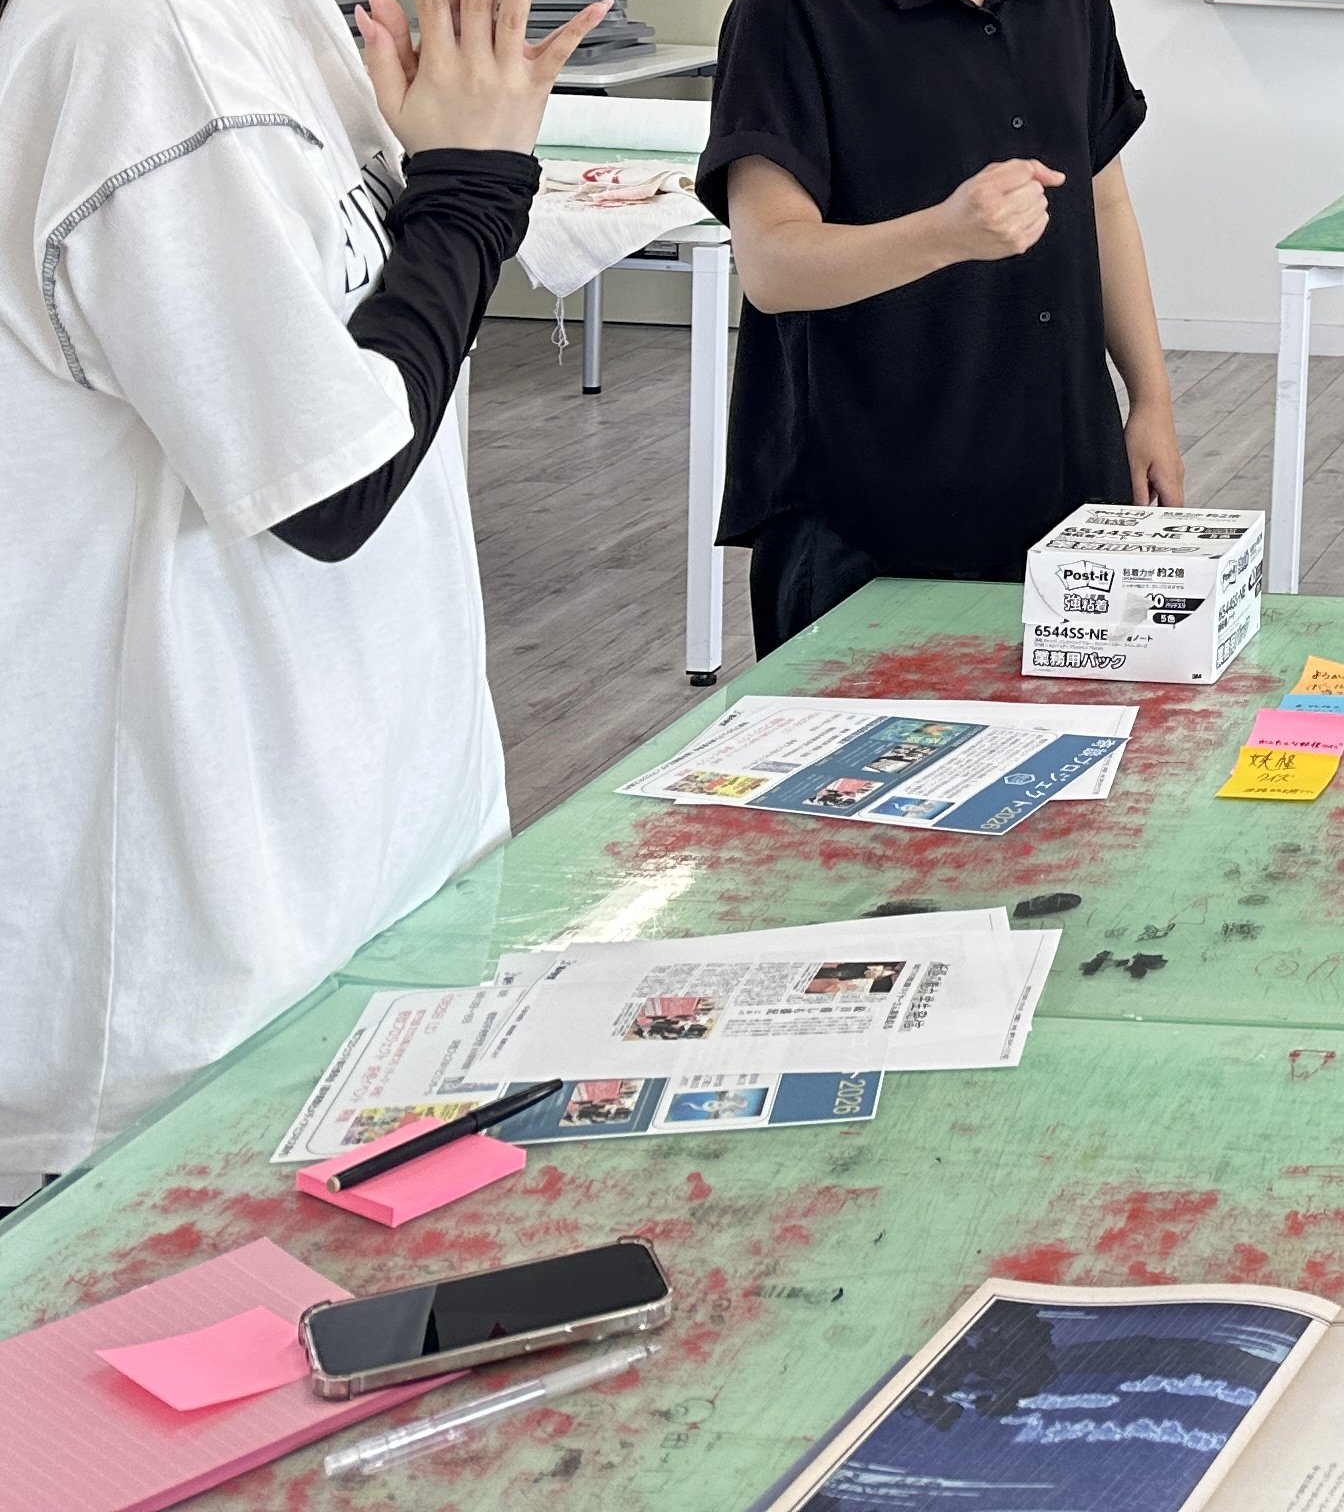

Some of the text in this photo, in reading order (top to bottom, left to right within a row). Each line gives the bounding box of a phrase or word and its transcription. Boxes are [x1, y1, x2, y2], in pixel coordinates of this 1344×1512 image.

[1063, 569, 1109, 583] Post-it
[1063, 592, 1110, 615] 強粘着
[1160, 614, 1177, 624] 5色
[1034, 625, 1109, 641] 6544SS-NE
[1032, 649, 1127, 670] 業務用パック
